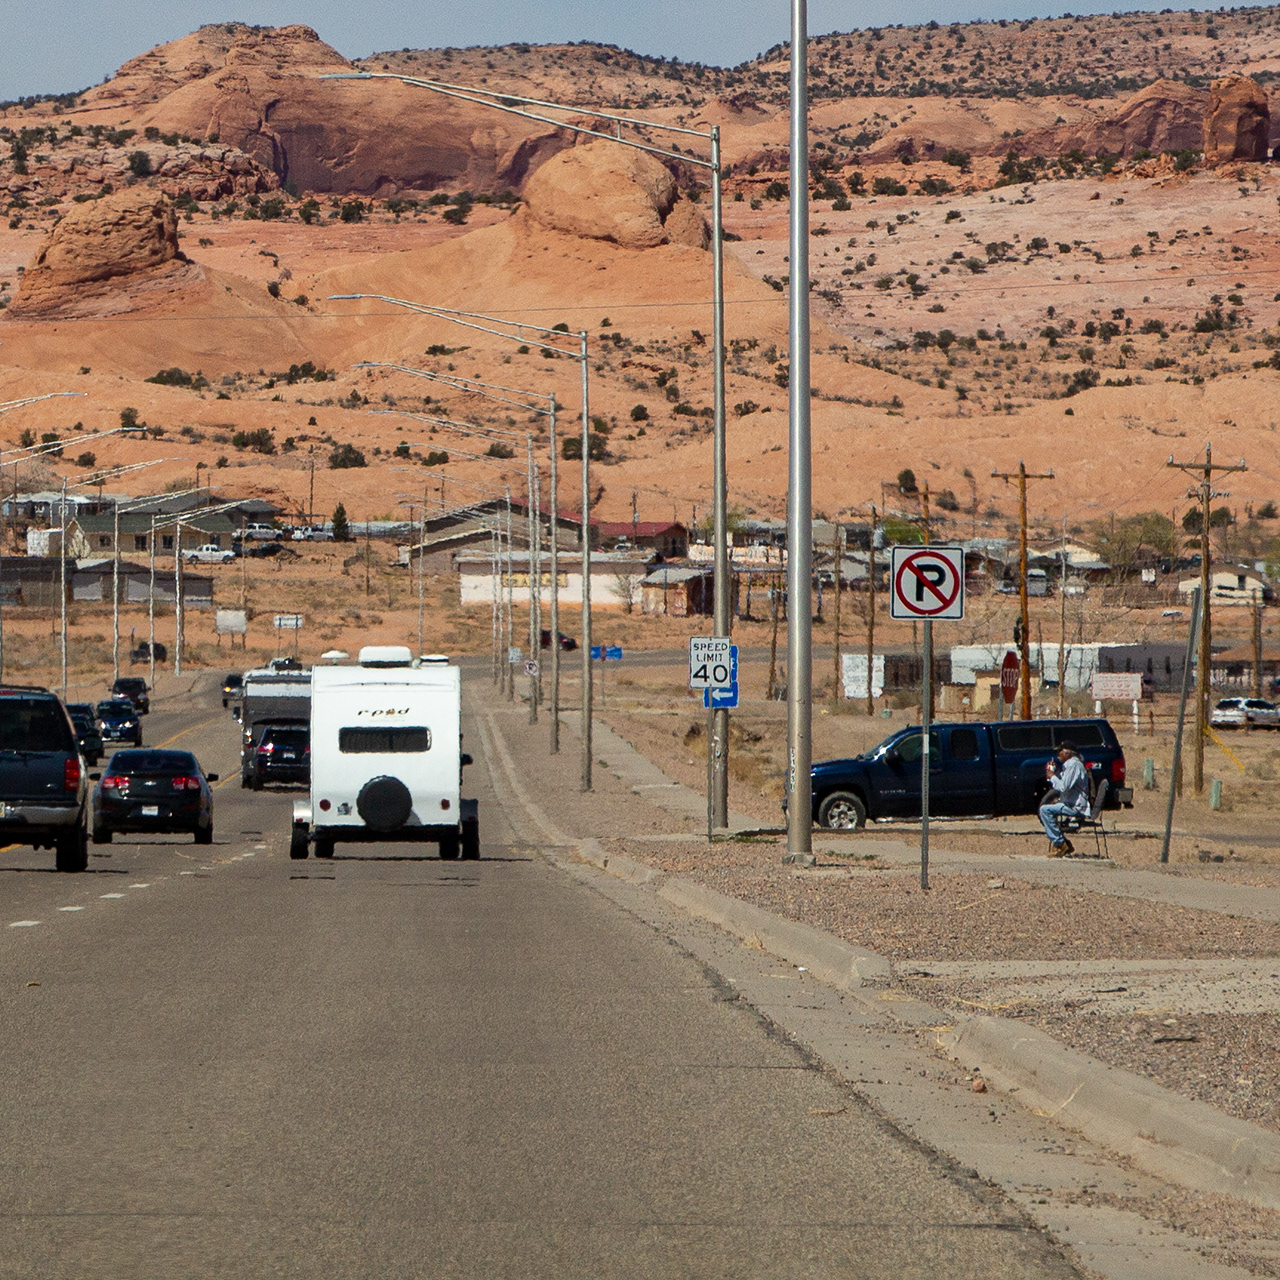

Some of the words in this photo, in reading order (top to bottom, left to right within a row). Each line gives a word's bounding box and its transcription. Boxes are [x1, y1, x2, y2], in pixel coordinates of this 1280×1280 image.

[693, 642, 728, 652] SPEED
[696, 653, 724, 663] LIMIT
[692, 664, 729, 683] 40
[1002, 668, 1019, 688] STOP
